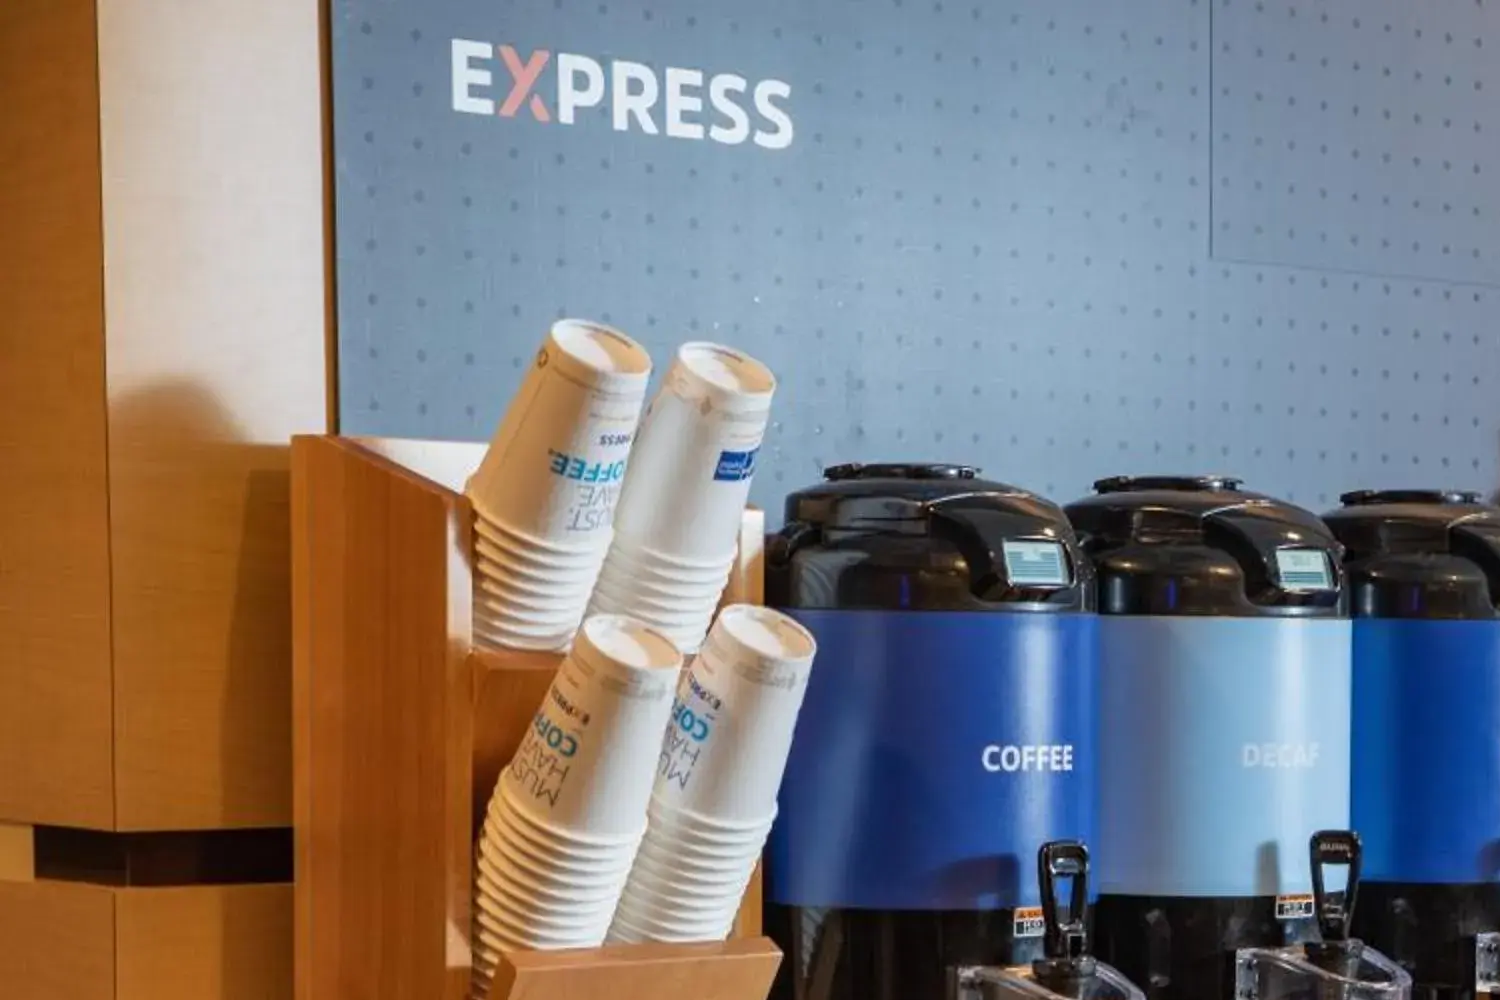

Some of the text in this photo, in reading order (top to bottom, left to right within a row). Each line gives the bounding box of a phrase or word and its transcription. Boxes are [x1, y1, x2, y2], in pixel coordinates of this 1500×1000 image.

[450, 38, 795, 150] EXPRESS
[548, 448, 625, 483] OFFEE.
[981, 744, 1074, 773] COFFEE
[1241, 741, 1321, 768] DECAF
